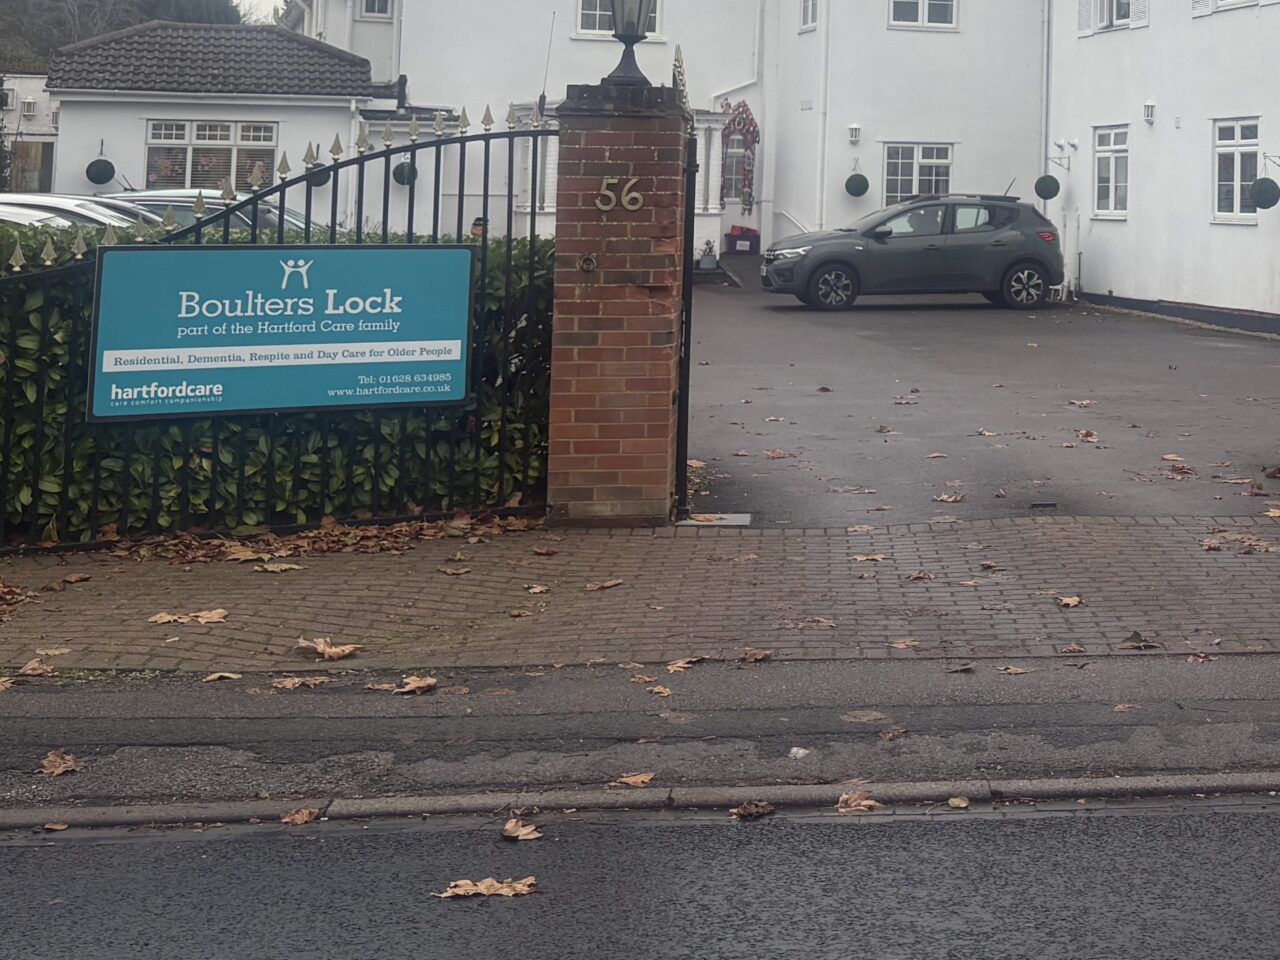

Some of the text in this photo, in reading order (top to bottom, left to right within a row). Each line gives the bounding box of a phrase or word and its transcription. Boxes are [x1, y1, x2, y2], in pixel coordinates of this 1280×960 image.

[595, 177, 644, 211] 56
[178, 288, 403, 318] Boulters Lock
[177, 319, 400, 339] part of the Hartford Care family
[114, 347, 452, 366] Residential, Dementia, Respite and Day Care for Older People
[358, 373, 452, 384] Tel: 01628 634985
[111, 381, 223, 400] hartfordcare
[327, 384, 451, 396] www.hartfordcare.co.uk
